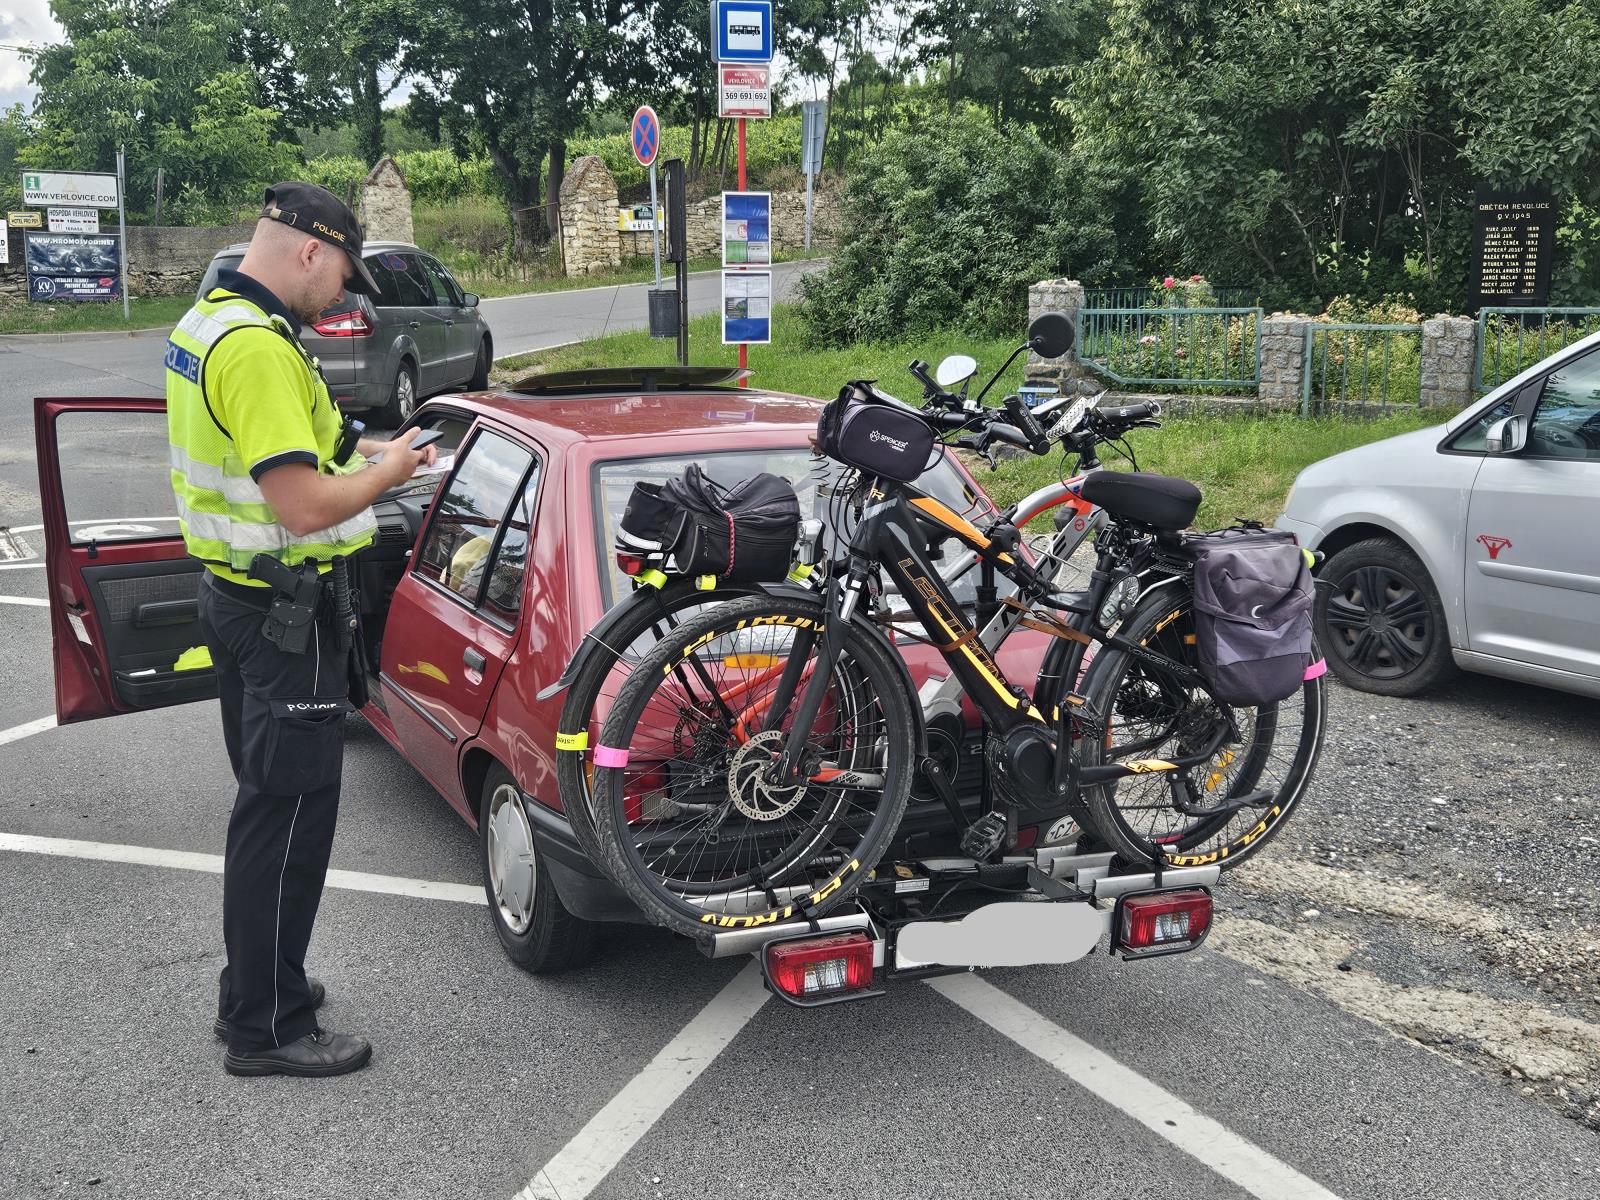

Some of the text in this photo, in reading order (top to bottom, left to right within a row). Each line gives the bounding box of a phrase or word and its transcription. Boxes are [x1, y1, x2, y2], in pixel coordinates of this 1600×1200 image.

[739, 92, 753, 100] 691
[754, 92, 767, 100] 692
[25, 192, 116, 203] WWW.VEHLOVICE.COM
[313, 220, 346, 243] POLICIE
